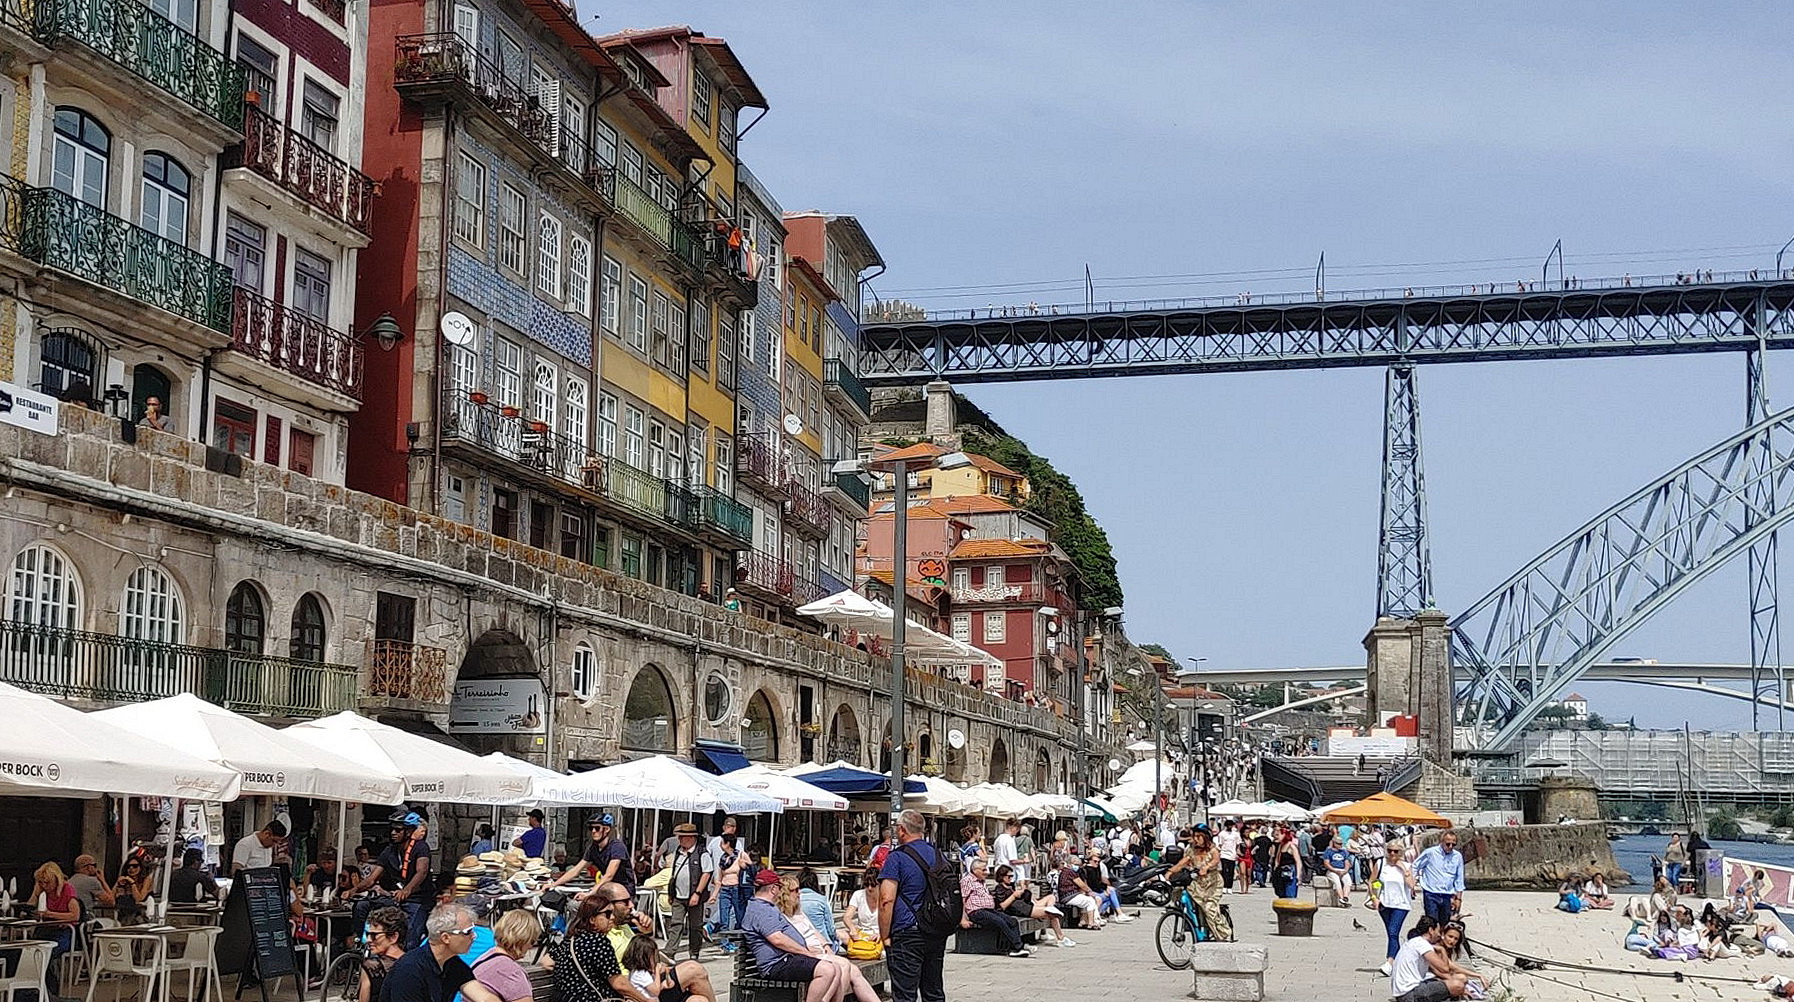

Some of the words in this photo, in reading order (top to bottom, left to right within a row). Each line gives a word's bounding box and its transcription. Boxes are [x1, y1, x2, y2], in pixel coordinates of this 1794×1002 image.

[16, 396, 52, 415] RESTAURANTE
[28, 411, 39, 420] BAR
[0, 762, 14, 775] ER
[16, 763, 43, 777] BOCK
[244, 772, 257, 784] PER
[257, 773, 275, 785] BOCK
[424, 783, 437, 793] BOCK
